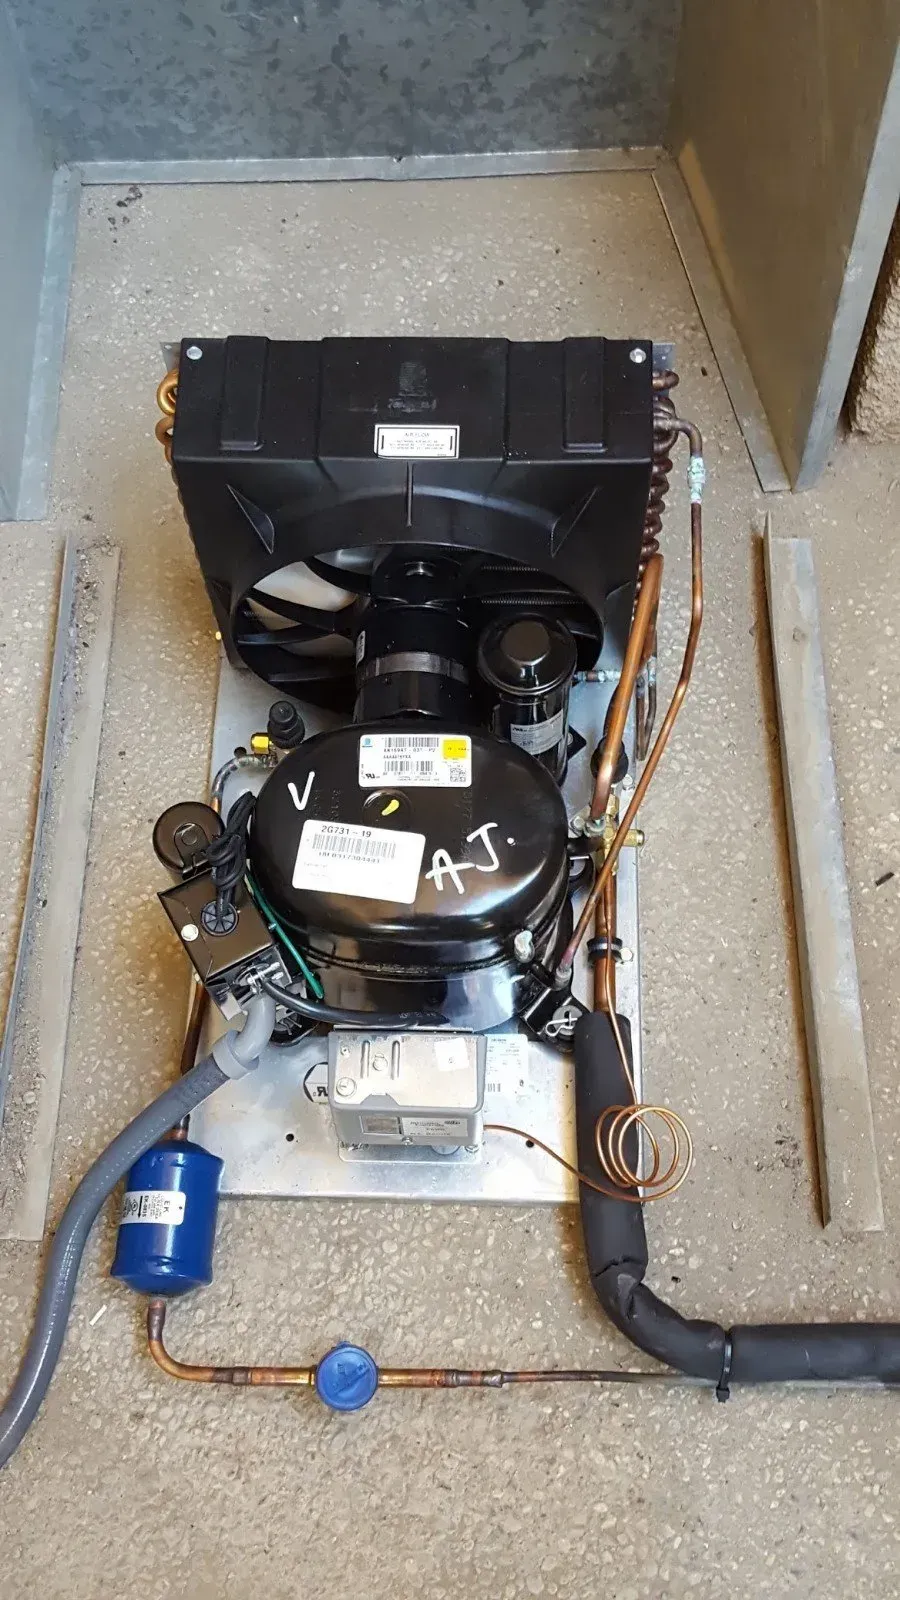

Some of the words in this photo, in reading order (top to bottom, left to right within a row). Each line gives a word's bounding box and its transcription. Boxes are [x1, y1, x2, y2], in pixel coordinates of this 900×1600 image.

[287, 771, 316, 811] V
[321, 825, 350, 835] 2G731
[163, 1200, 170, 1213] EK
